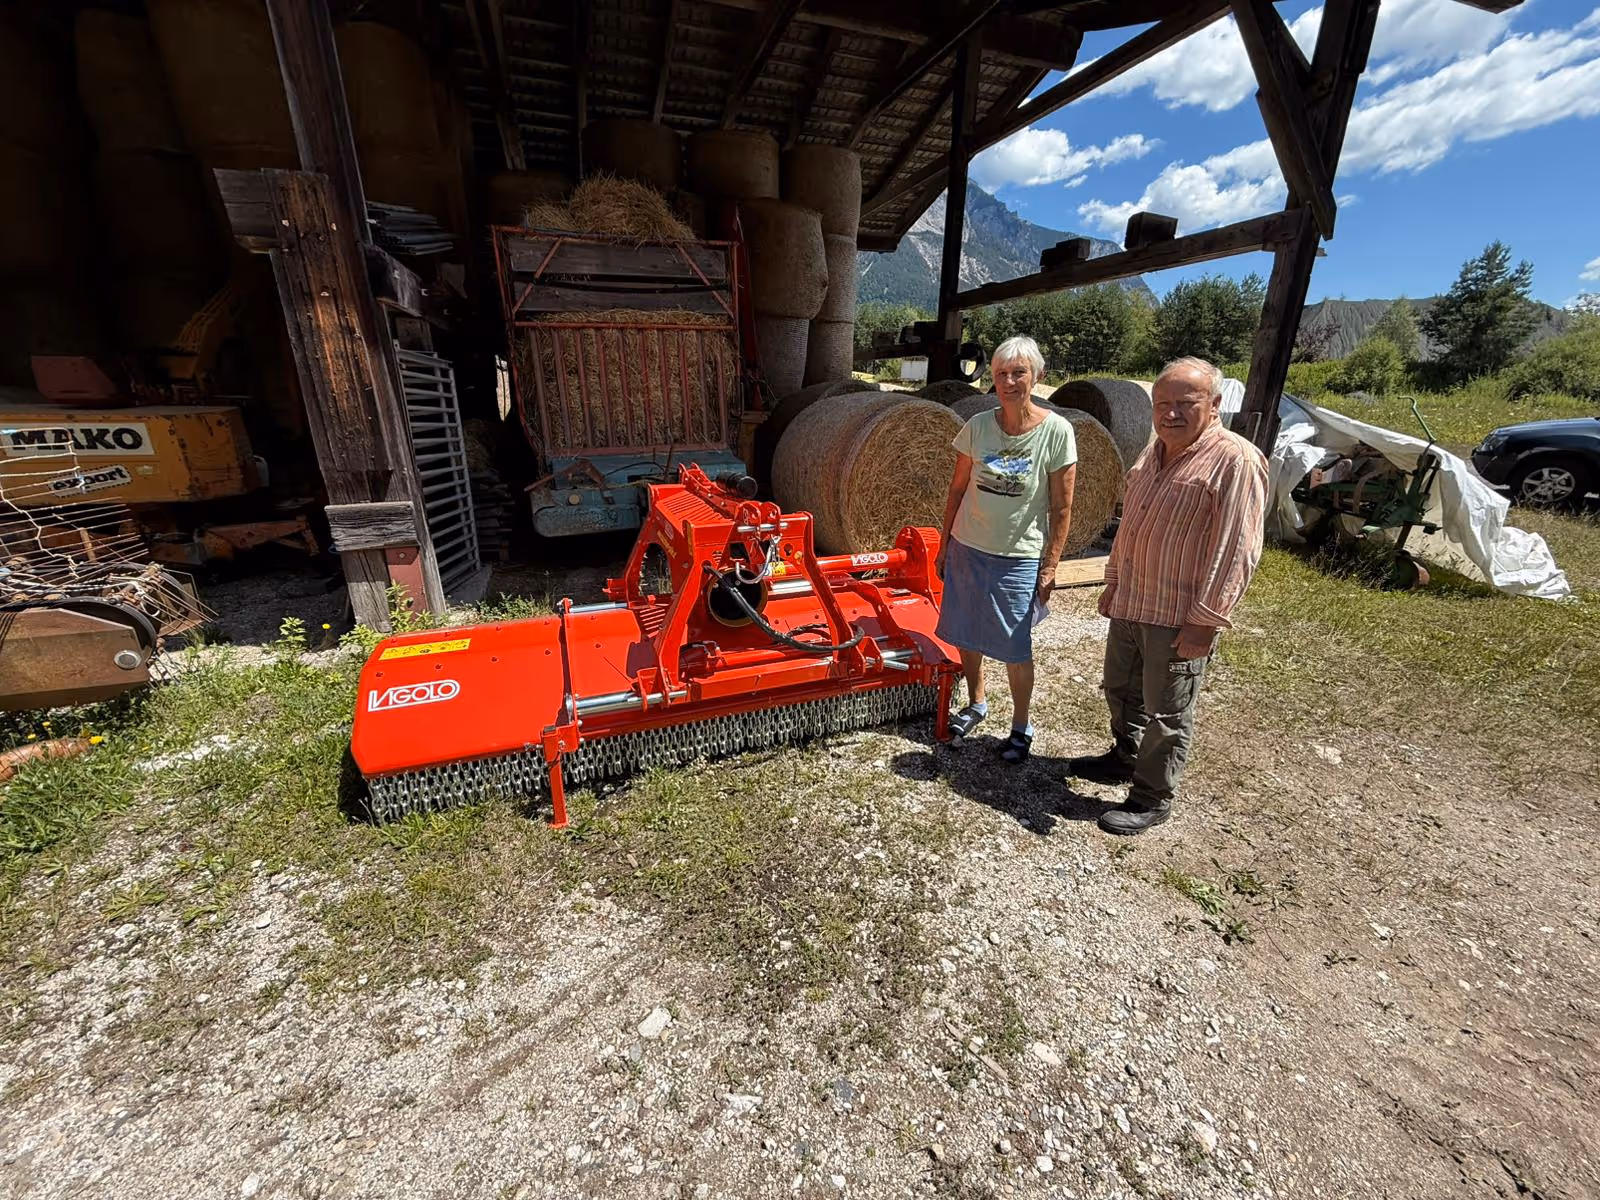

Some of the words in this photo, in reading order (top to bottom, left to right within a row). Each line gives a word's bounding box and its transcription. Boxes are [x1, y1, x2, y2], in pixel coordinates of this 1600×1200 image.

[11, 427, 143, 450] MAKO
[53, 467, 127, 490] export
[851, 552, 889, 566] VIGOLO
[368, 679, 461, 712] VIGOLO
